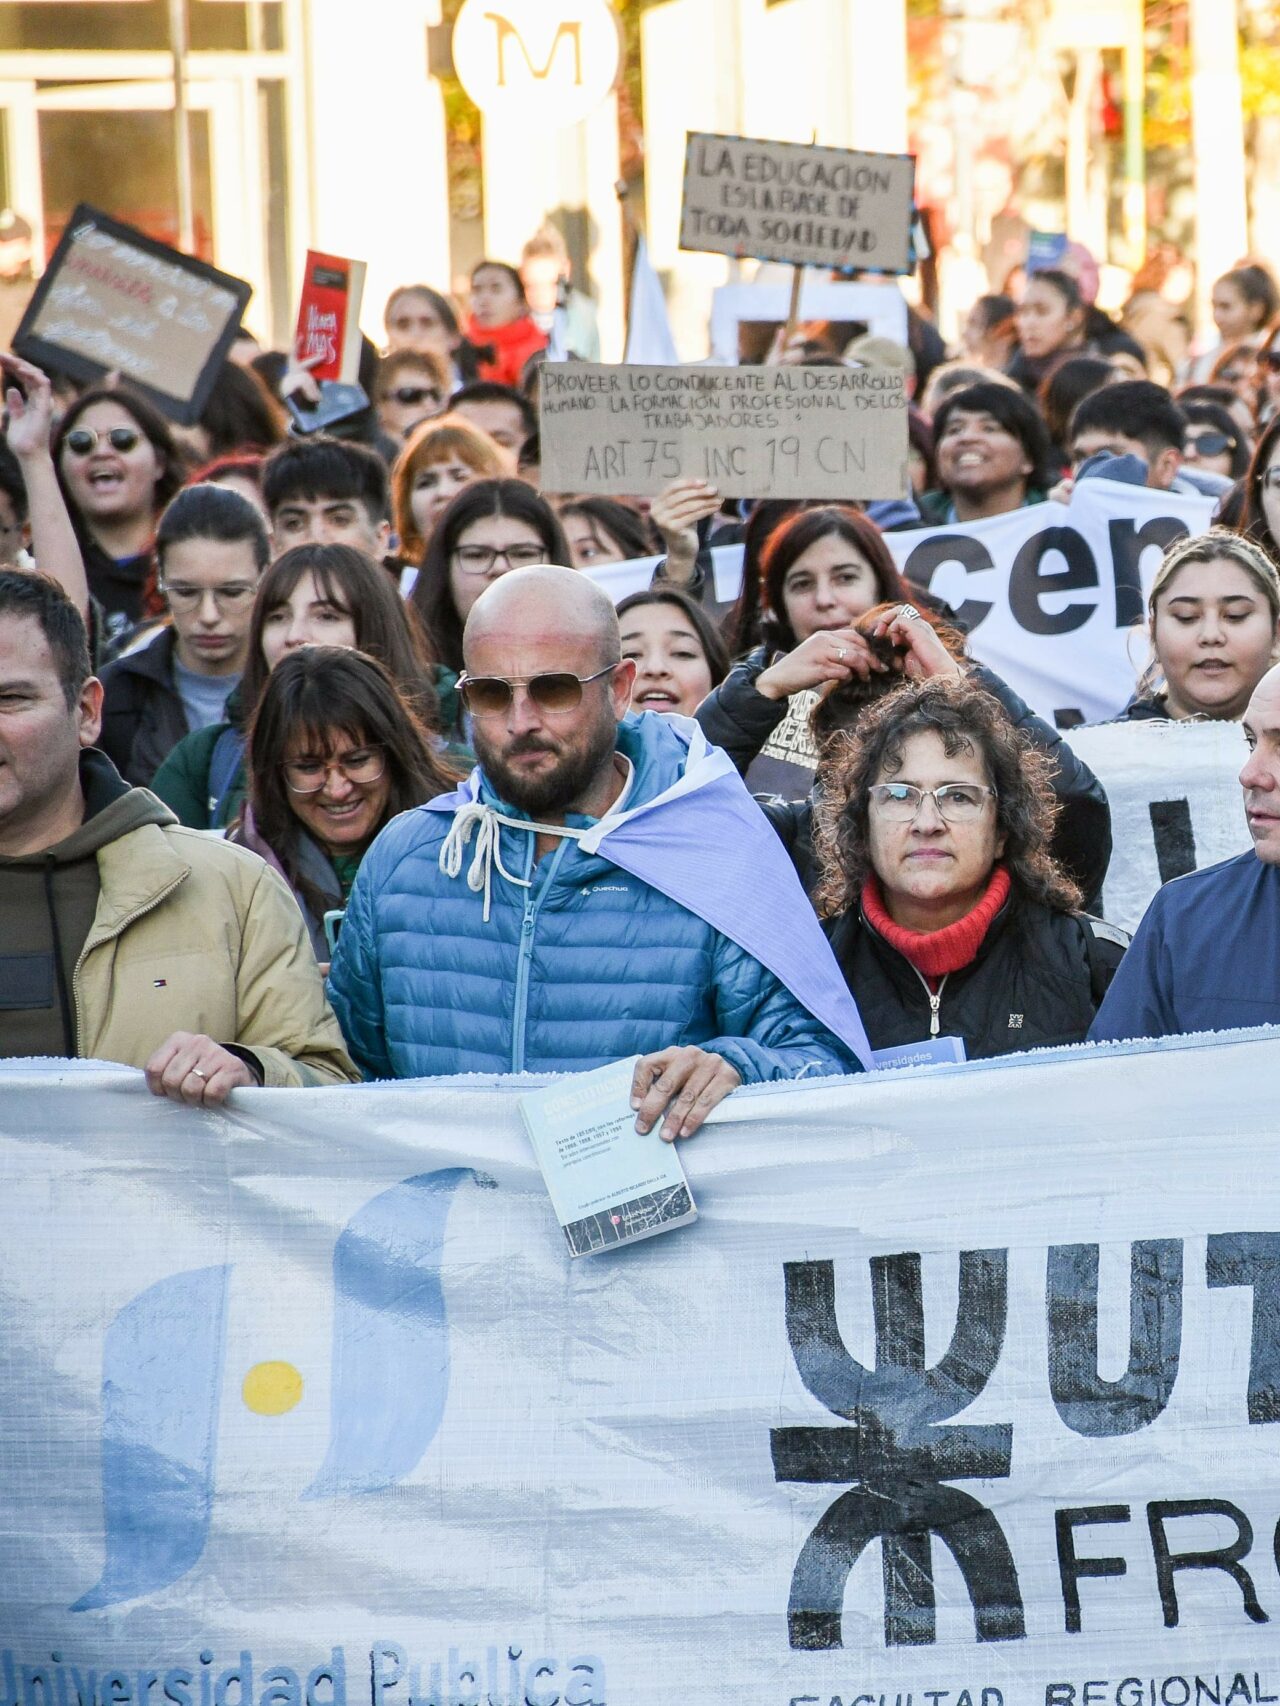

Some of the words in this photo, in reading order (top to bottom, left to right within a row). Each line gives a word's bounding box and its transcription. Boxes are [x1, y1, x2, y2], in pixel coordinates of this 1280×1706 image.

[697, 145, 735, 177] LA
[690, 206, 750, 238] TODA
[759, 217, 878, 252] SOCIEDAD
[545, 373, 621, 395] PROVEER
[629, 373, 650, 391] LO
[655, 373, 765, 392] CONDUCENTE
[775, 372, 798, 391] AL
[803, 371, 903, 390] DESARROLLO
[544, 396, 596, 414] HUMANO
[610, 397, 630, 413] LA
[730, 394, 846, 411] PROFESIONAL
[644, 412, 779, 430] TRABAJADORES
[585, 440, 631, 481] ART
[641, 440, 681, 478] 75
[704, 444, 747, 477] INC
[766, 436, 800, 476] 19
[816, 437, 866, 474] CN
